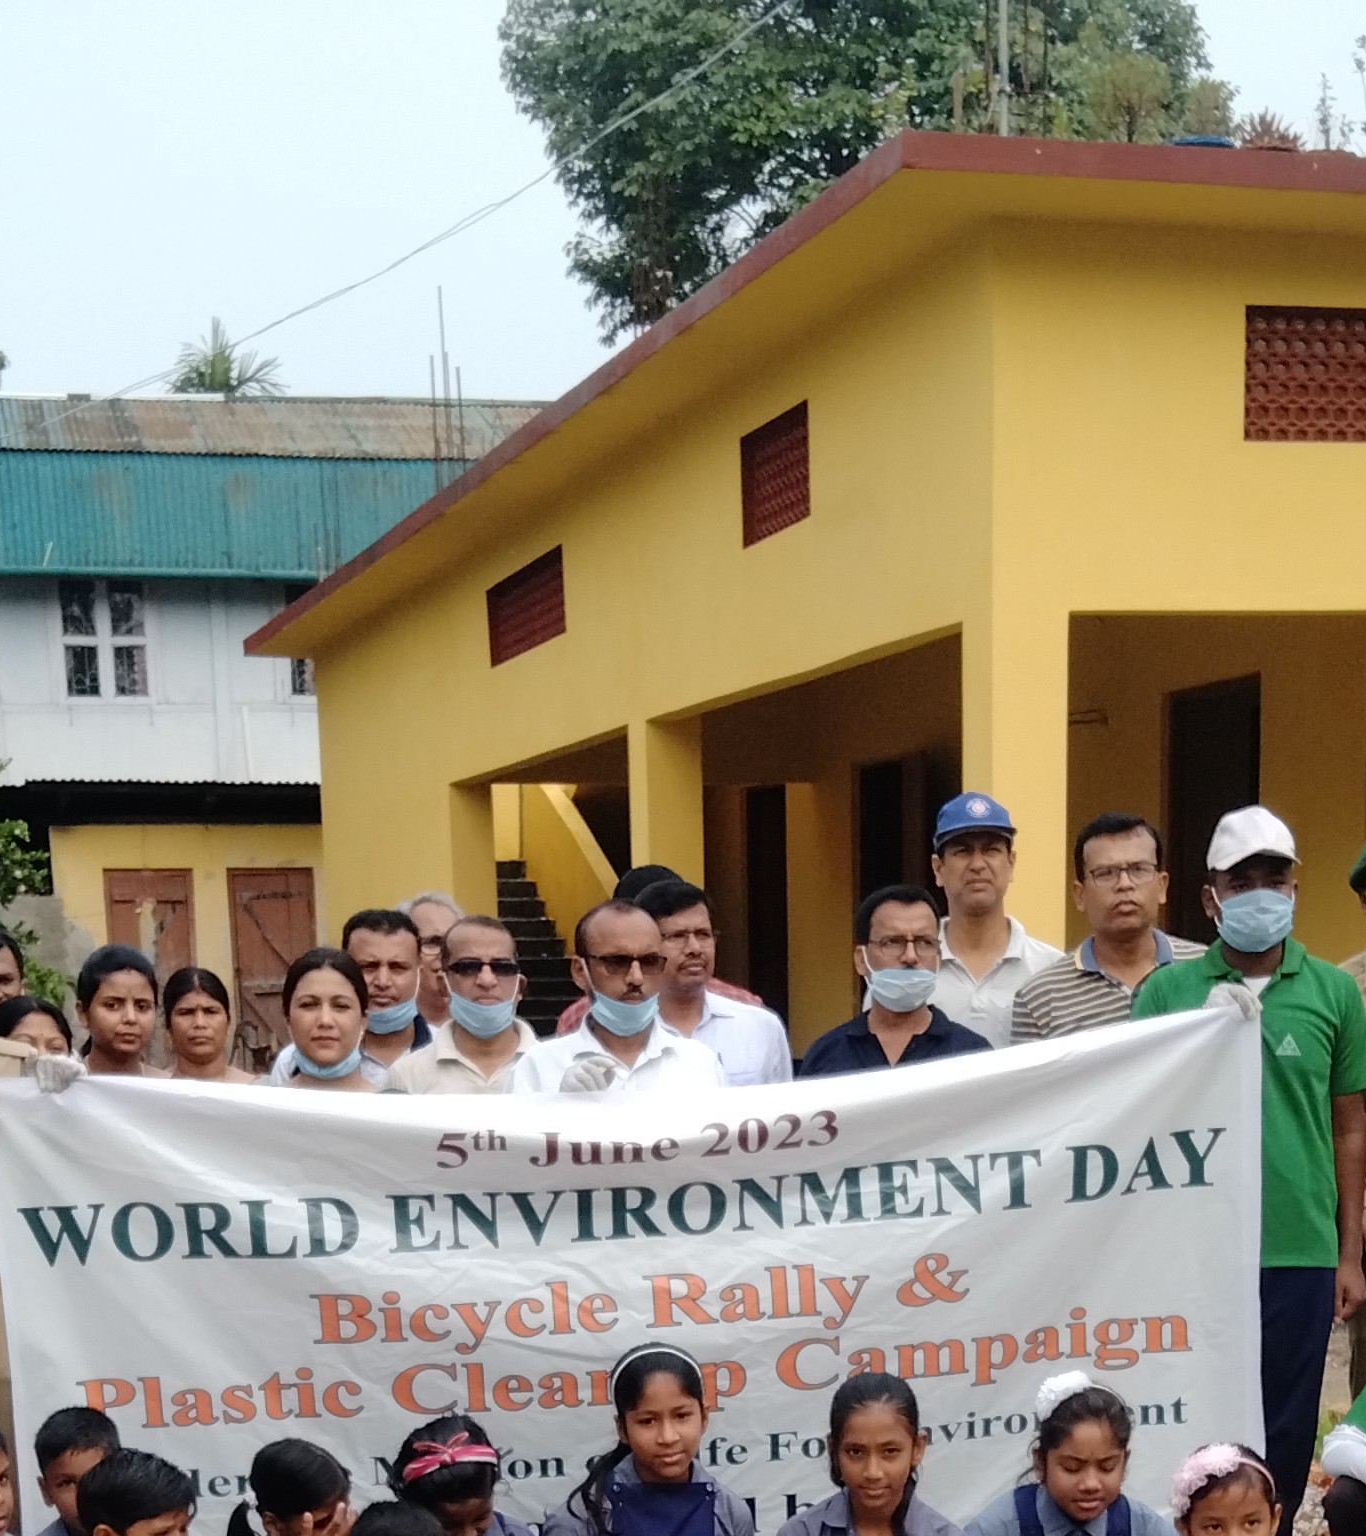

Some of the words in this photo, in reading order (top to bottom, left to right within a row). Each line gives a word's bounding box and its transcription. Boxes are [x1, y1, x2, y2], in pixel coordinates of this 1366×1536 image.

[436, 1129, 508, 1169] 5th
[529, 1131, 681, 1168] June
[700, 1109, 839, 1158] 2023
[17, 1196, 359, 1268] WORLD
[384, 1149, 1042, 1254] ENVIRONMENT
[1064, 1127, 1227, 1204] DAY
[309, 1281, 620, 1355] Bicycle
[642, 1263, 870, 1330] Rally
[895, 1252, 970, 1307] &
[76, 1367, 365, 1430] Plastic
[391, 1360, 747, 1416] Cleap
[775, 1307, 1193, 1387] Campaign
[765, 1430, 828, 1463] Fo
